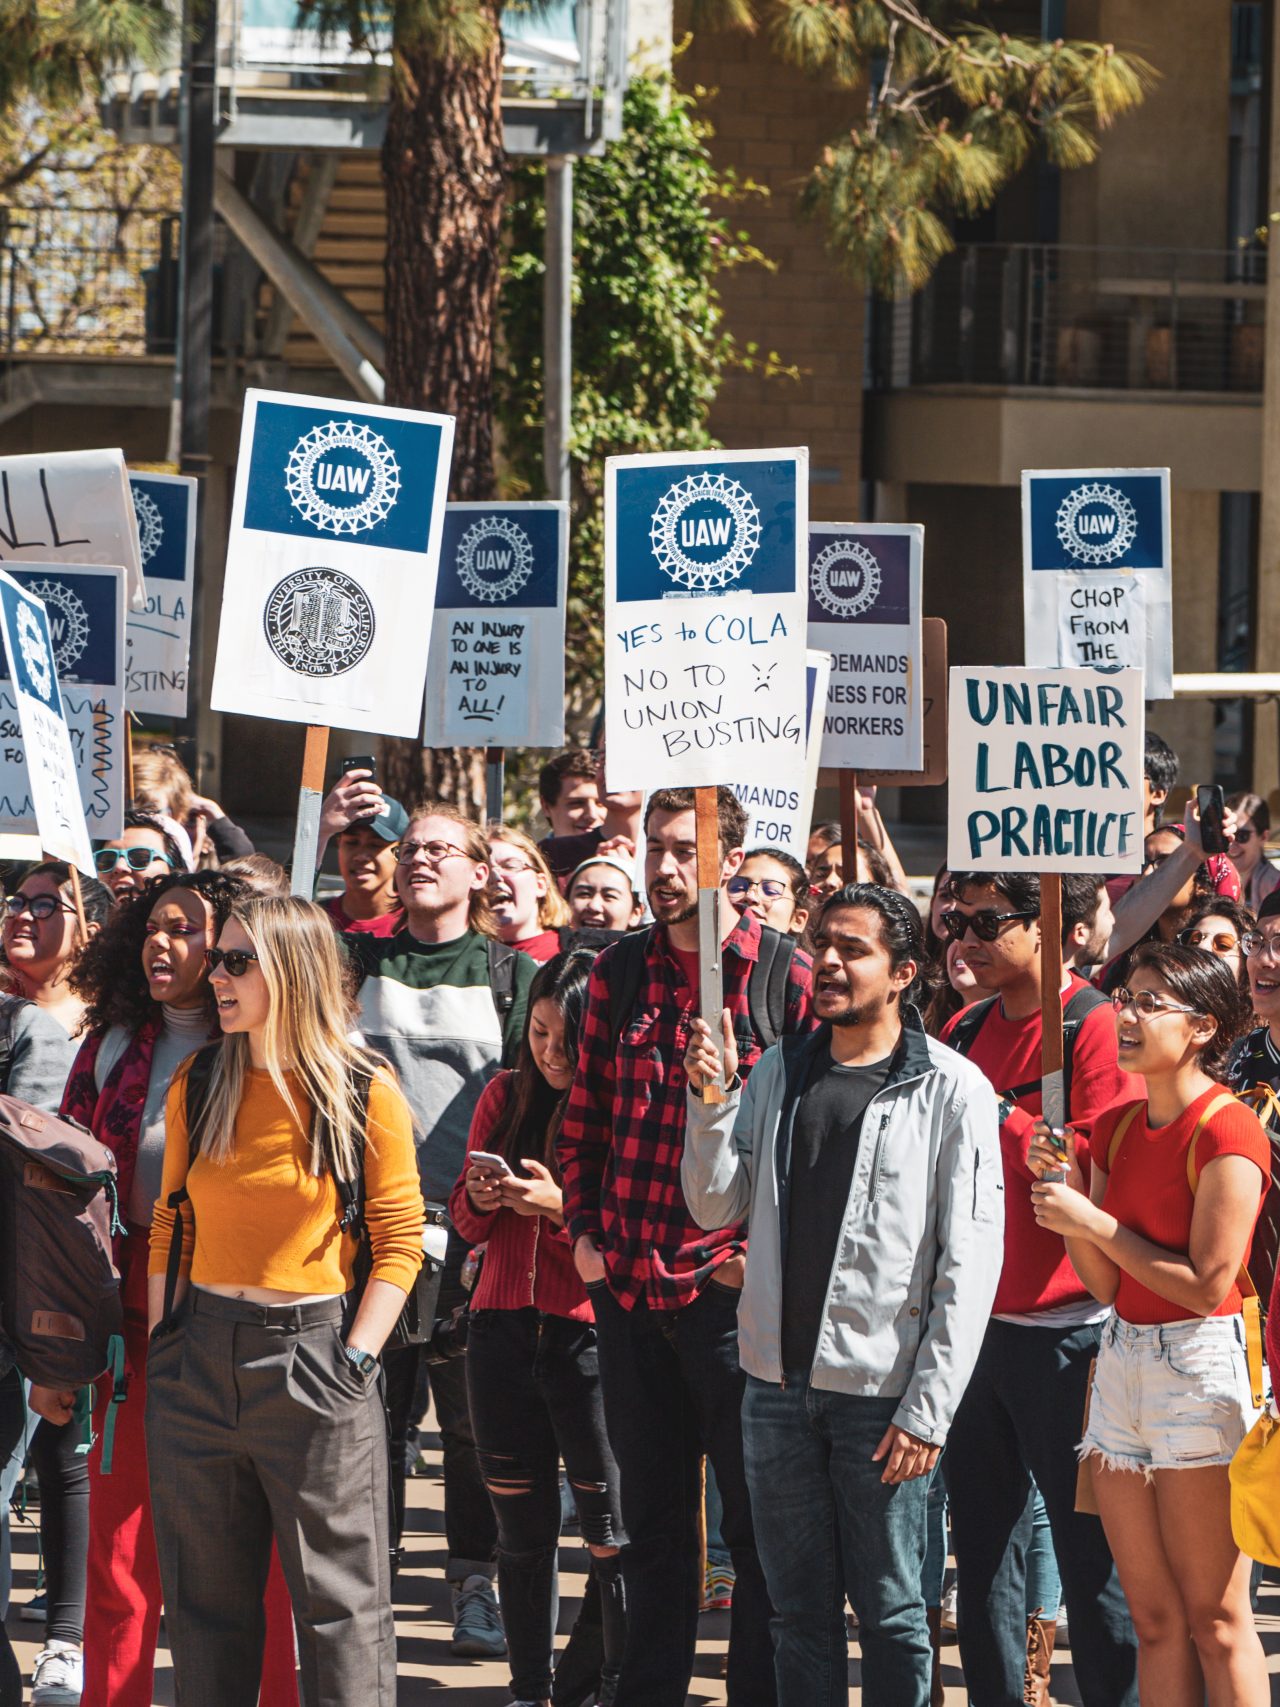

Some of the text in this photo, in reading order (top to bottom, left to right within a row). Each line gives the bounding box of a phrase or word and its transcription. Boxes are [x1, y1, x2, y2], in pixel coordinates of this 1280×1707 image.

[317, 463, 371, 494] UAW
[682, 518, 731, 547] UAW
[1078, 514, 1115, 535] UAW
[476, 550, 512, 570] UAW
[830, 571, 860, 587] UAW
[130, 595, 185, 621] OLA
[1070, 587, 1124, 608] CHOP
[269, 571, 370, 665] THE UNIVERSITY OF CALIFORNIA
[1070, 615, 1129, 636] FROM
[452, 621, 525, 639] AN INJURY
[617, 613, 787, 652] YES to COLA
[451, 639, 522, 655] TO ONE IS
[1077, 642, 1118, 661] THE
[301, 663, 326, 673] NOW
[450, 660, 522, 678] AN INJURY
[125, 670, 185, 692] STING
[462, 678, 487, 692] TO
[624, 664, 725, 696] NO TO
[458, 695, 505, 715] ALL!
[827, 685, 907, 705] NESS FOR
[965, 678, 1127, 728] UNFAIR
[624, 695, 722, 729] UNION
[663, 714, 800, 757] BUSTING
[823, 716, 904, 736] WORKERS
[975, 741, 1130, 793] LABOR
[723, 783, 799, 810] MANDS
[755, 820, 792, 843] FOR
[967, 804, 1137, 860] PRACTICE
